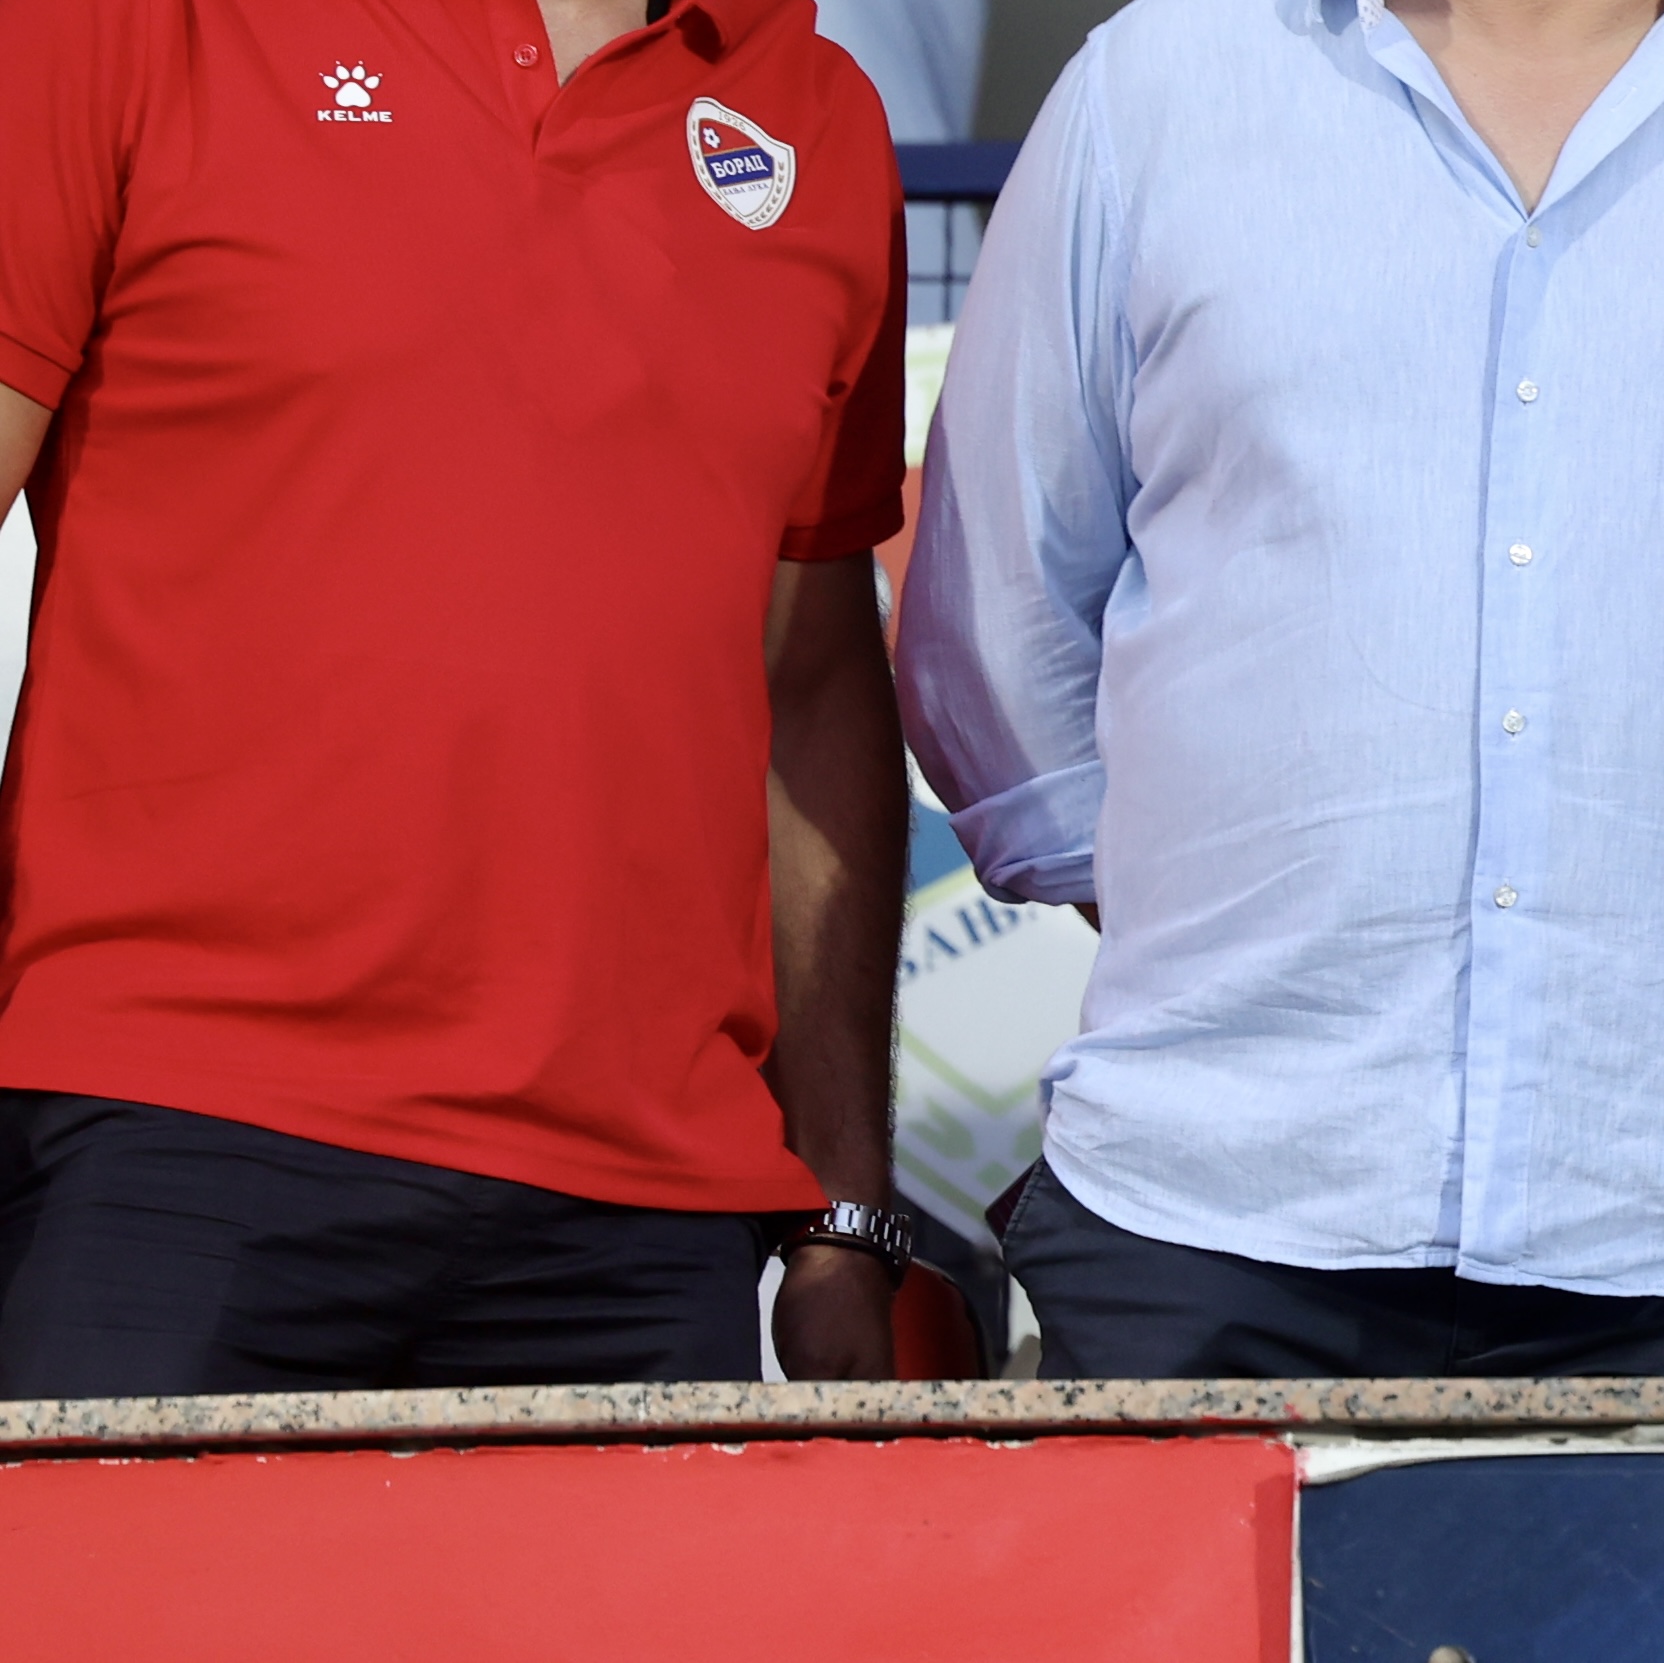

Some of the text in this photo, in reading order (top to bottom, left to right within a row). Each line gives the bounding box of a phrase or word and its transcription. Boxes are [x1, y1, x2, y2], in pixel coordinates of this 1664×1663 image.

[317, 109, 393, 123] KELME
[718, 111, 746, 132] 1926
[710, 154, 769, 178] БОРАЦ
